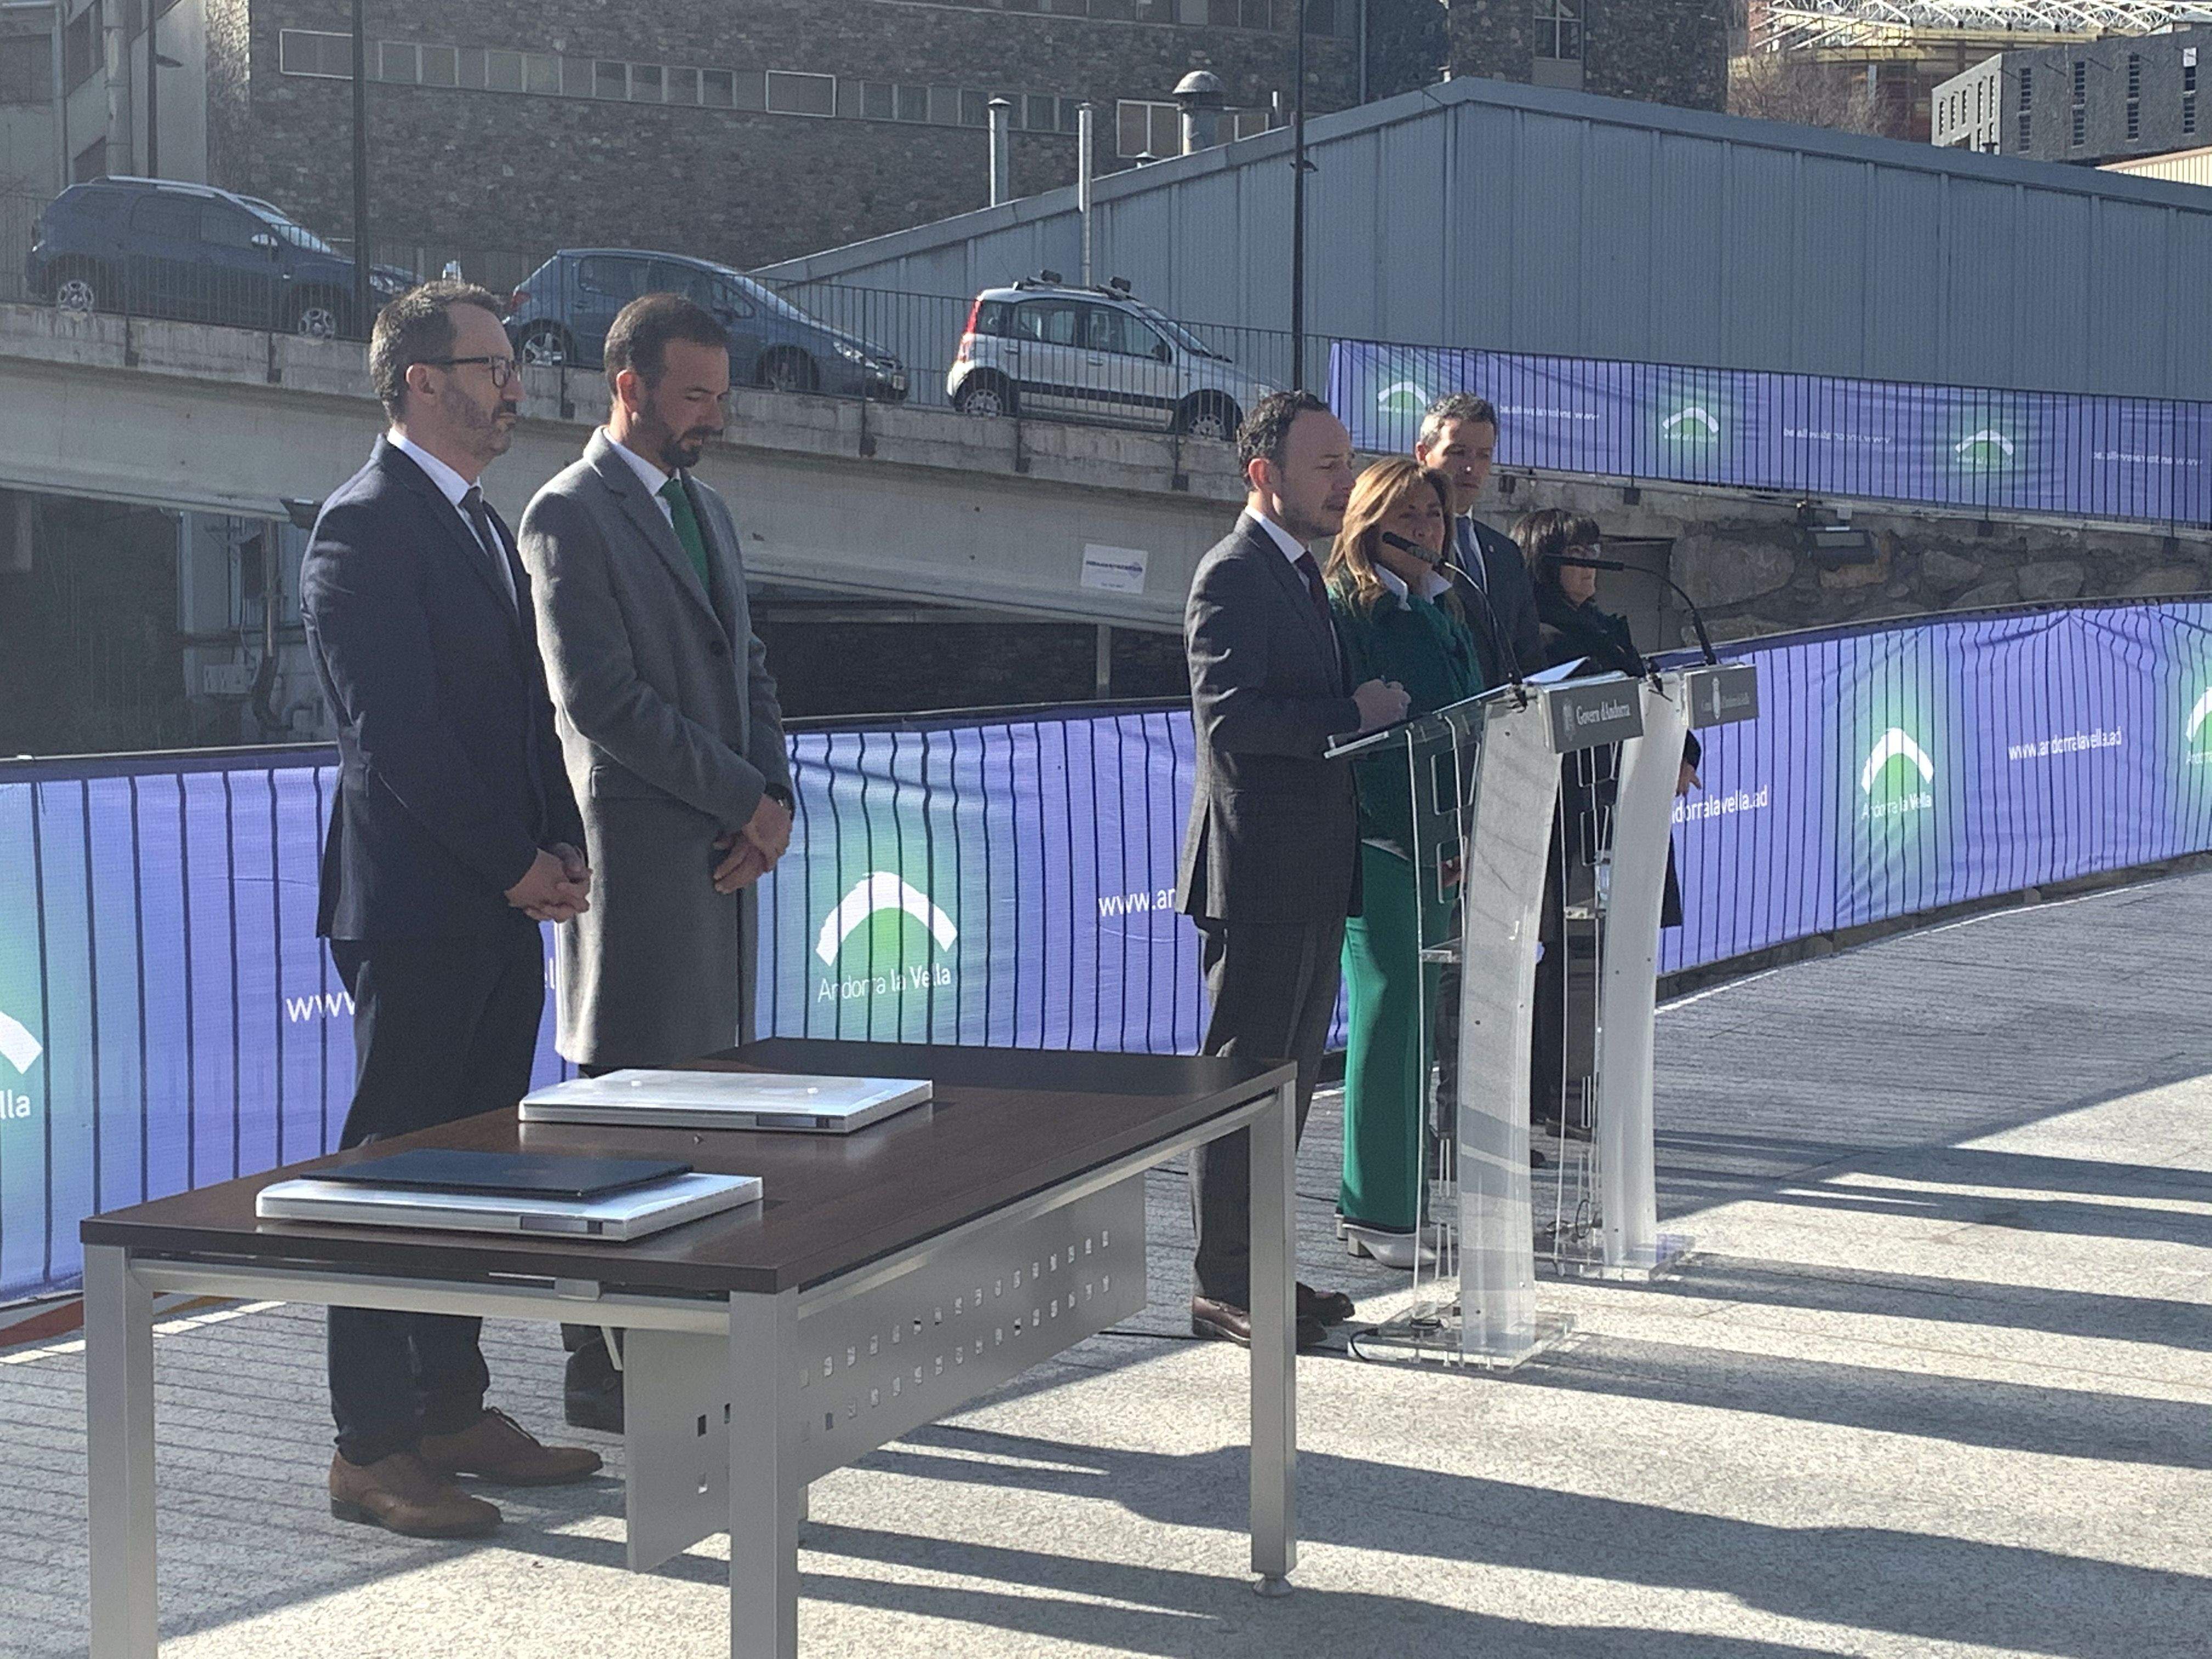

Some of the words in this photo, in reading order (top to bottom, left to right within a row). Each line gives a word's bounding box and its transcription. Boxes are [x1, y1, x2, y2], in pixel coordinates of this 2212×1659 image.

[2008, 726, 2122, 761] www.andorralavella.ad
[1861, 800, 1898, 820] Andorra
[1899, 795, 1909, 812] la
[1909, 792, 1932, 810] Vella
[817, 975, 886, 1003] Andorra
[890, 968, 906, 992] la
[909, 963, 951, 990] Vella
[0, 1088, 31, 1119] lla
